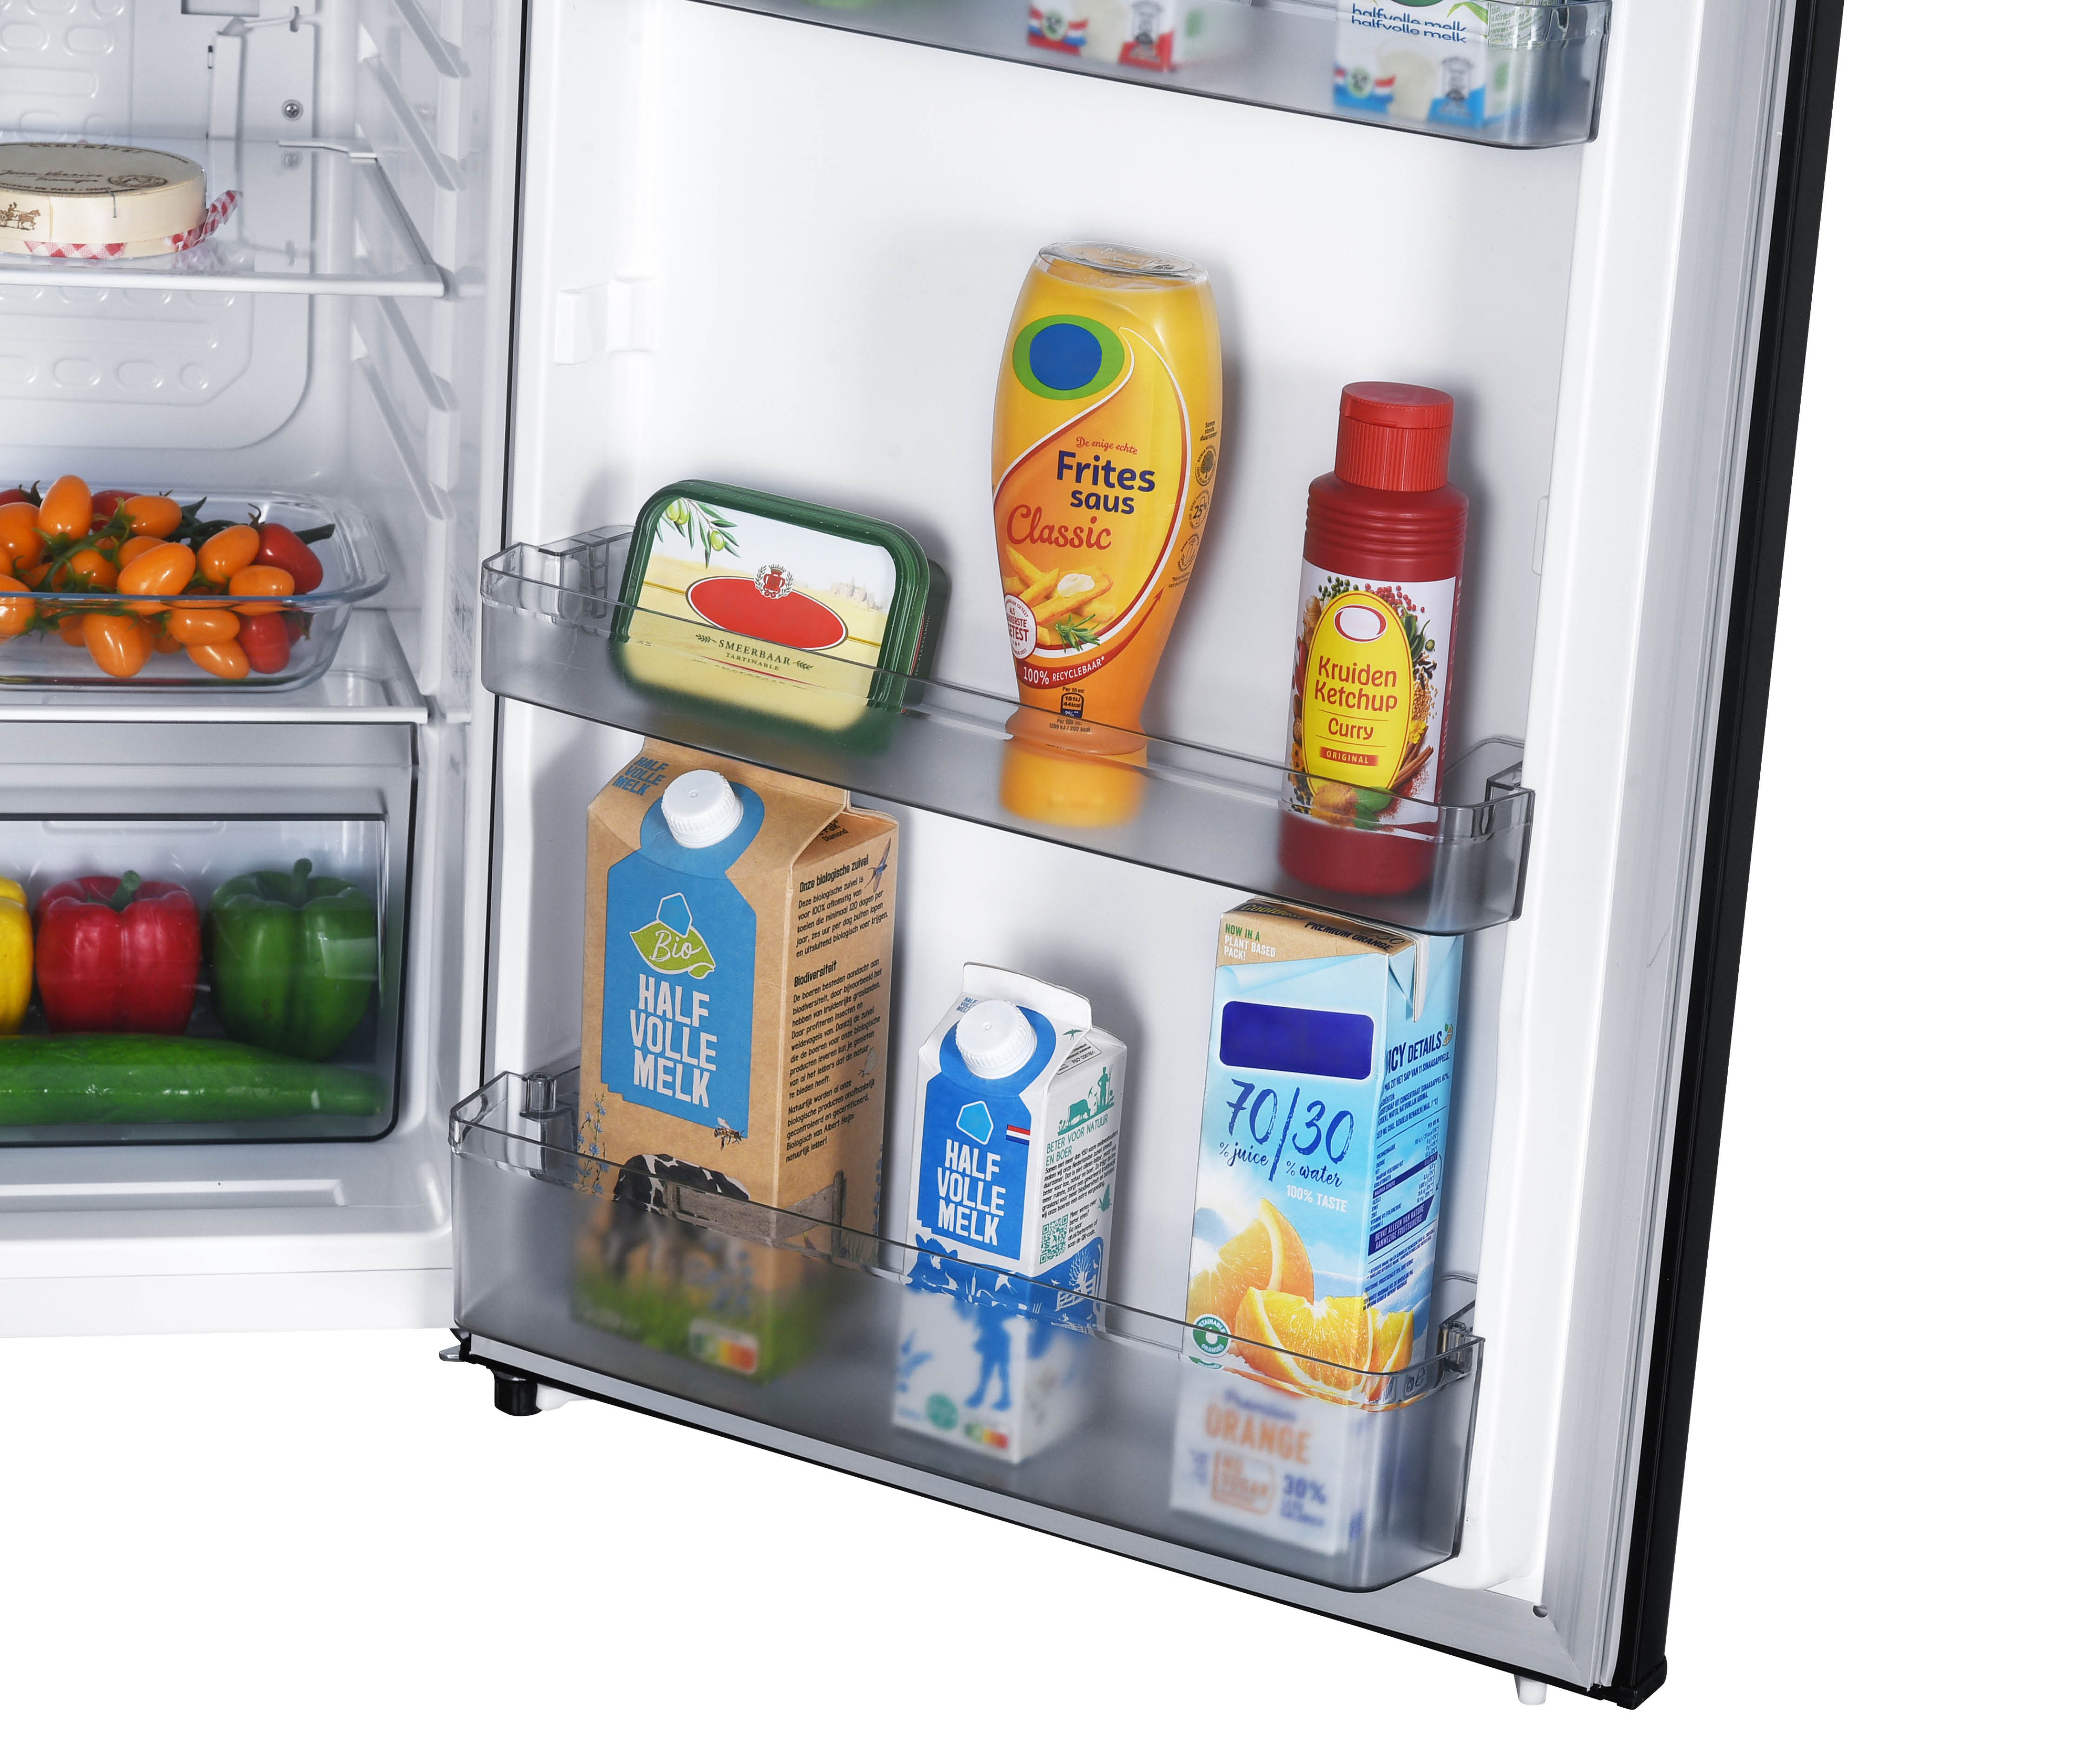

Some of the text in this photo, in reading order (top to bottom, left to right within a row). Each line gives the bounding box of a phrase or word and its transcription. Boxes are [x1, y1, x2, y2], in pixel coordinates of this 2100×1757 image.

[1351, 15, 1466, 43] halfvolle melk
[1076, 436, 1138, 455] De enige echte
[1057, 450, 1155, 492] Frites
[1070, 490, 1135, 515] saus
[1007, 504, 1111, 550] Classic
[719, 639, 791, 666] SMEERBAAR
[726, 652, 779, 671] TARTINABLE
[1024, 667, 1049, 685] 100%
[1318, 655, 1398, 688] Kruiden
[1314, 679, 1398, 713] Ketchup
[1328, 717, 1374, 740] Curry
[633, 756, 669, 772] HALF
[1326, 750, 1369, 765] ORIGINAL
[612, 775, 651, 796] MELK
[625, 765, 666, 786] VOLLE
[799, 854, 869, 893] Onze biologische zuivel
[798, 911, 811, 921] voor
[812, 903, 825, 915] 100%
[853, 889, 862, 898] van
[799, 898, 812, 909] Deze
[813, 886, 842, 903] biologische
[844, 877, 858, 891] zuivel
[816, 917, 824, 926] die
[825, 905, 848, 922] minimaal
[849, 901, 858, 912] 120
[858, 895, 874, 907] dagen
[874, 890, 884, 902] per
[812, 931, 820, 940] zes
[822, 926, 830, 935] uur
[832, 922, 841, 933] per
[842, 917, 852, 926] dag
[853, 909, 869, 922] buiten
[870, 902, 883, 914] lopen
[1225, 923, 1260, 942] NOW IN A
[1305, 921, 1353, 938] PREMIUM
[1352, 933, 1393, 951] ORANGE
[649, 930, 703, 962] Bio
[805, 936, 832, 955] uitsluitend
[833, 925, 858, 943] biologisch
[859, 920, 871, 930] voer
[1224, 946, 1246, 961] PACK!
[1225, 935, 1276, 957] PLANT BASED
[793, 959, 879, 1003] De boeren besteden aandacht aan
[830, 988, 843, 999] door
[874, 968, 882, 978] het
[638, 973, 710, 1028] HALF
[792, 1014, 812, 1027] hebben
[813, 1009, 822, 1018] van
[853, 982, 880, 1002] graslanden.
[791, 1032, 823, 1051] weidevogels
[824, 1028, 834, 1037] van.
[853, 1015, 860, 1023] de
[861, 1006, 874, 1019] zuivel
[792, 1029, 805, 1039] Daar
[806, 1016, 833, 1035] profiteren
[835, 1005, 856, 1020] insecten
[630, 1009, 718, 1071] VOLLE
[1386, 1030, 1443, 1074] ICY DETAILS
[634, 1049, 710, 1108] MELK
[796, 1083, 814, 1096] bieden
[815, 1075, 830, 1088] heeft.
[814, 1089, 832, 1103] worden
[833, 1084, 839, 1094] al
[840, 1080, 852, 1090] onze
[787, 1109, 817, 1127] biologische
[818, 1095, 844, 1115] producten
[786, 1133, 812, 1151] Biologisch
[813, 1129, 823, 1138] van
[824, 1119, 840, 1133] Albert
[1047, 1113, 1108, 1154] BETER VOOR NATUUR
[944, 1138, 1001, 1181] HALF
[1046, 1145, 1072, 1167] EN BOER
[1227, 1142, 1269, 1167] juice
[938, 1167, 1006, 1216] VOLLE
[1300, 1165, 1343, 1187] water
[1287, 1184, 1348, 1213] 100% TASTE
[938, 1199, 999, 1246] MELK
[1205, 1403, 1311, 1466] ORANGE
